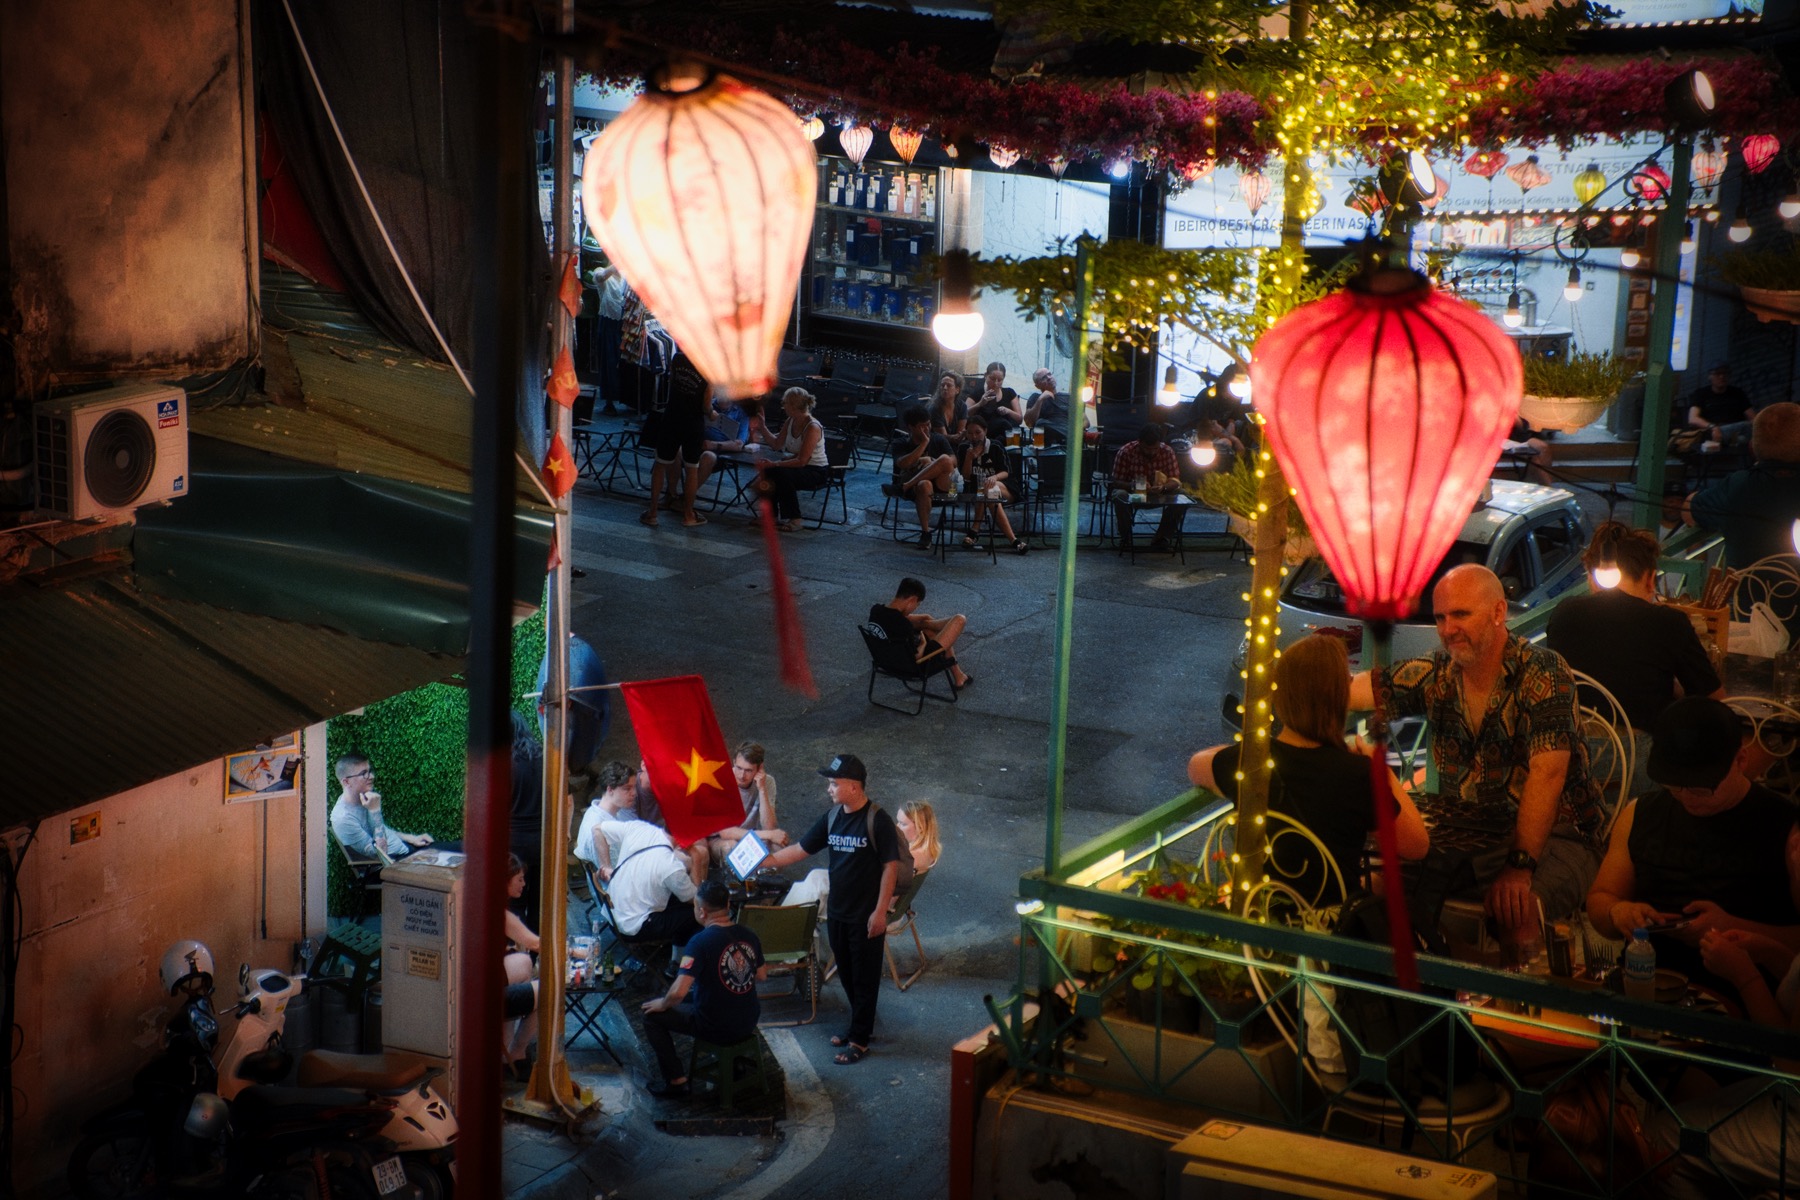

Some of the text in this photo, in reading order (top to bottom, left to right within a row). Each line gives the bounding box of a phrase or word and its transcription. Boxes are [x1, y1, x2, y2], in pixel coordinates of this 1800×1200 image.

[1174, 219, 1216, 232] IBEIRO
[1219, 218, 1249, 231] BEST
[1253, 217, 1284, 231] CRAF
[1305, 218, 1329, 230] EER
[1333, 217, 1345, 230] IN
[159, 418, 178, 428] Funiki
[828, 834, 868, 848] SSENTIALS
